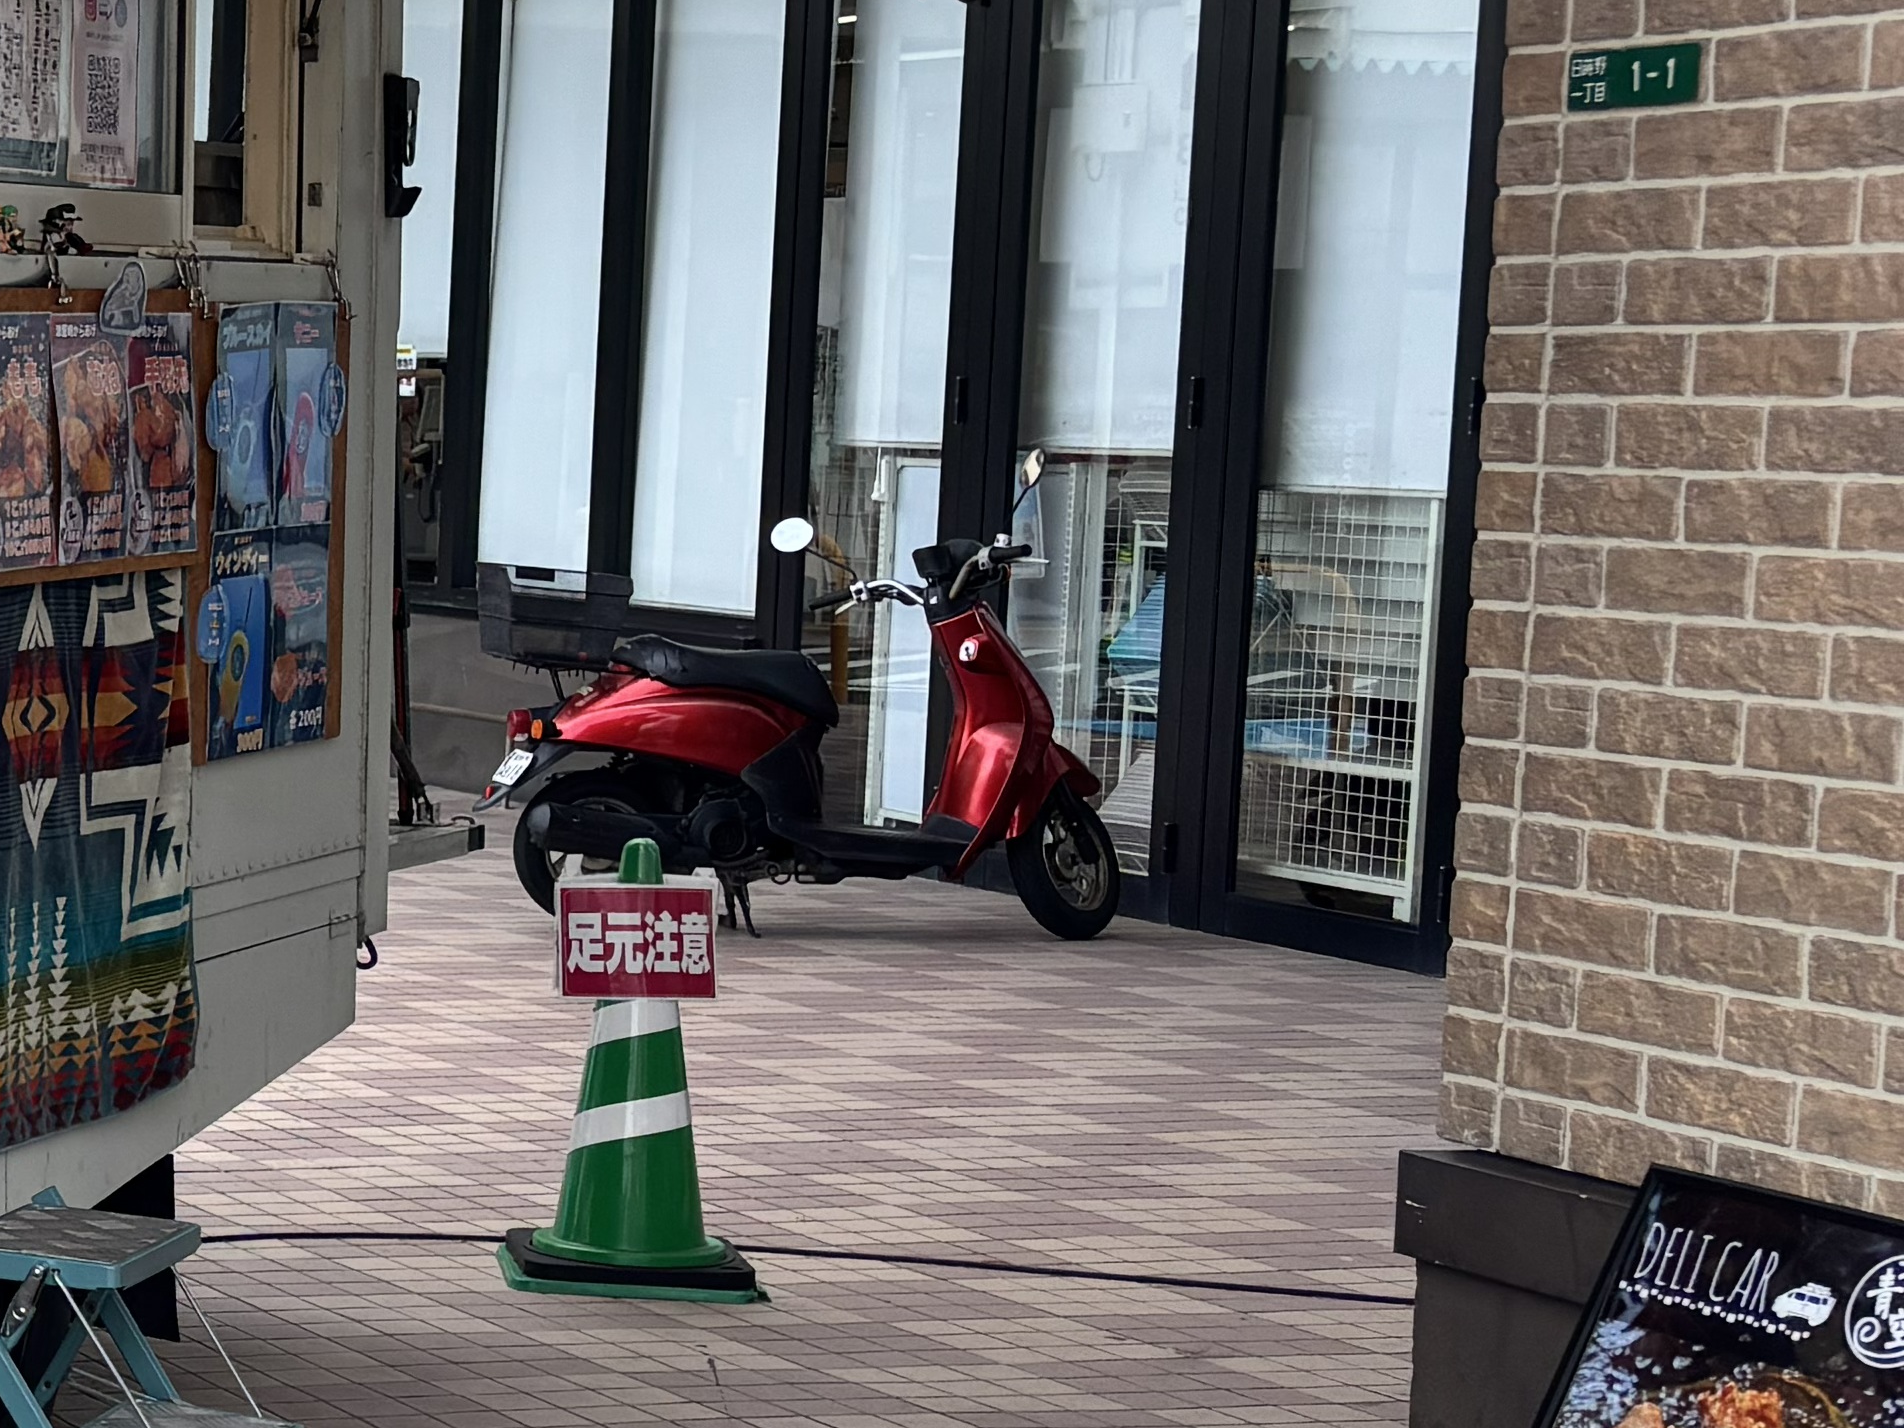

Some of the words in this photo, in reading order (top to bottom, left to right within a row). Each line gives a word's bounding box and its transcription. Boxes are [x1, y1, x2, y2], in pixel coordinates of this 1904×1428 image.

[1631, 57, 1676, 92] 1-1
[8, 358, 42, 398] もも
[567, 910, 711, 976] 足元注意
[1633, 1222, 1714, 1294] DELI
[1708, 1240, 1780, 1314] CAR
